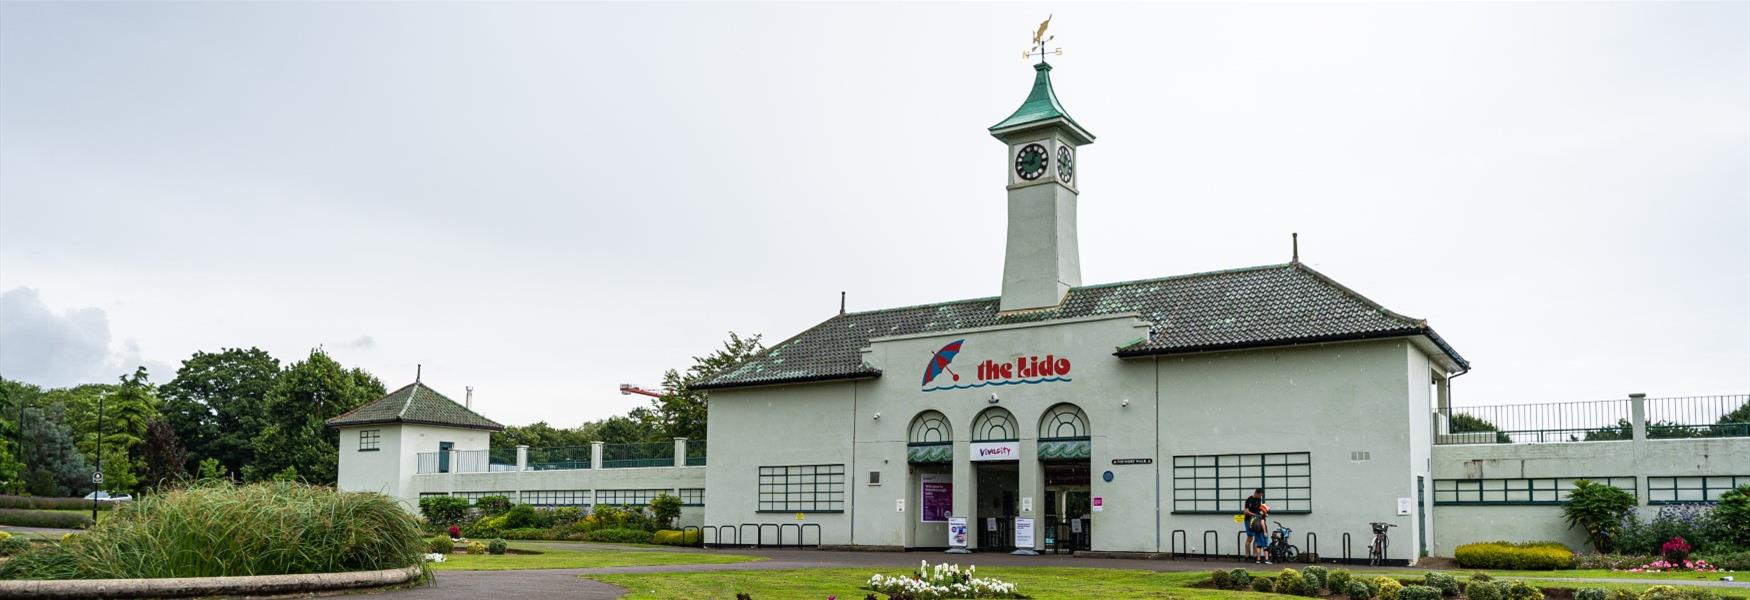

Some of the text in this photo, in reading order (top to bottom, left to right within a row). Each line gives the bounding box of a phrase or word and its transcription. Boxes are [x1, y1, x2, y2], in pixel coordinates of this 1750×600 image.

[1023, 51, 1030, 59] N
[1056, 50, 1063, 58] S
[977, 355, 1070, 381] the Lido
